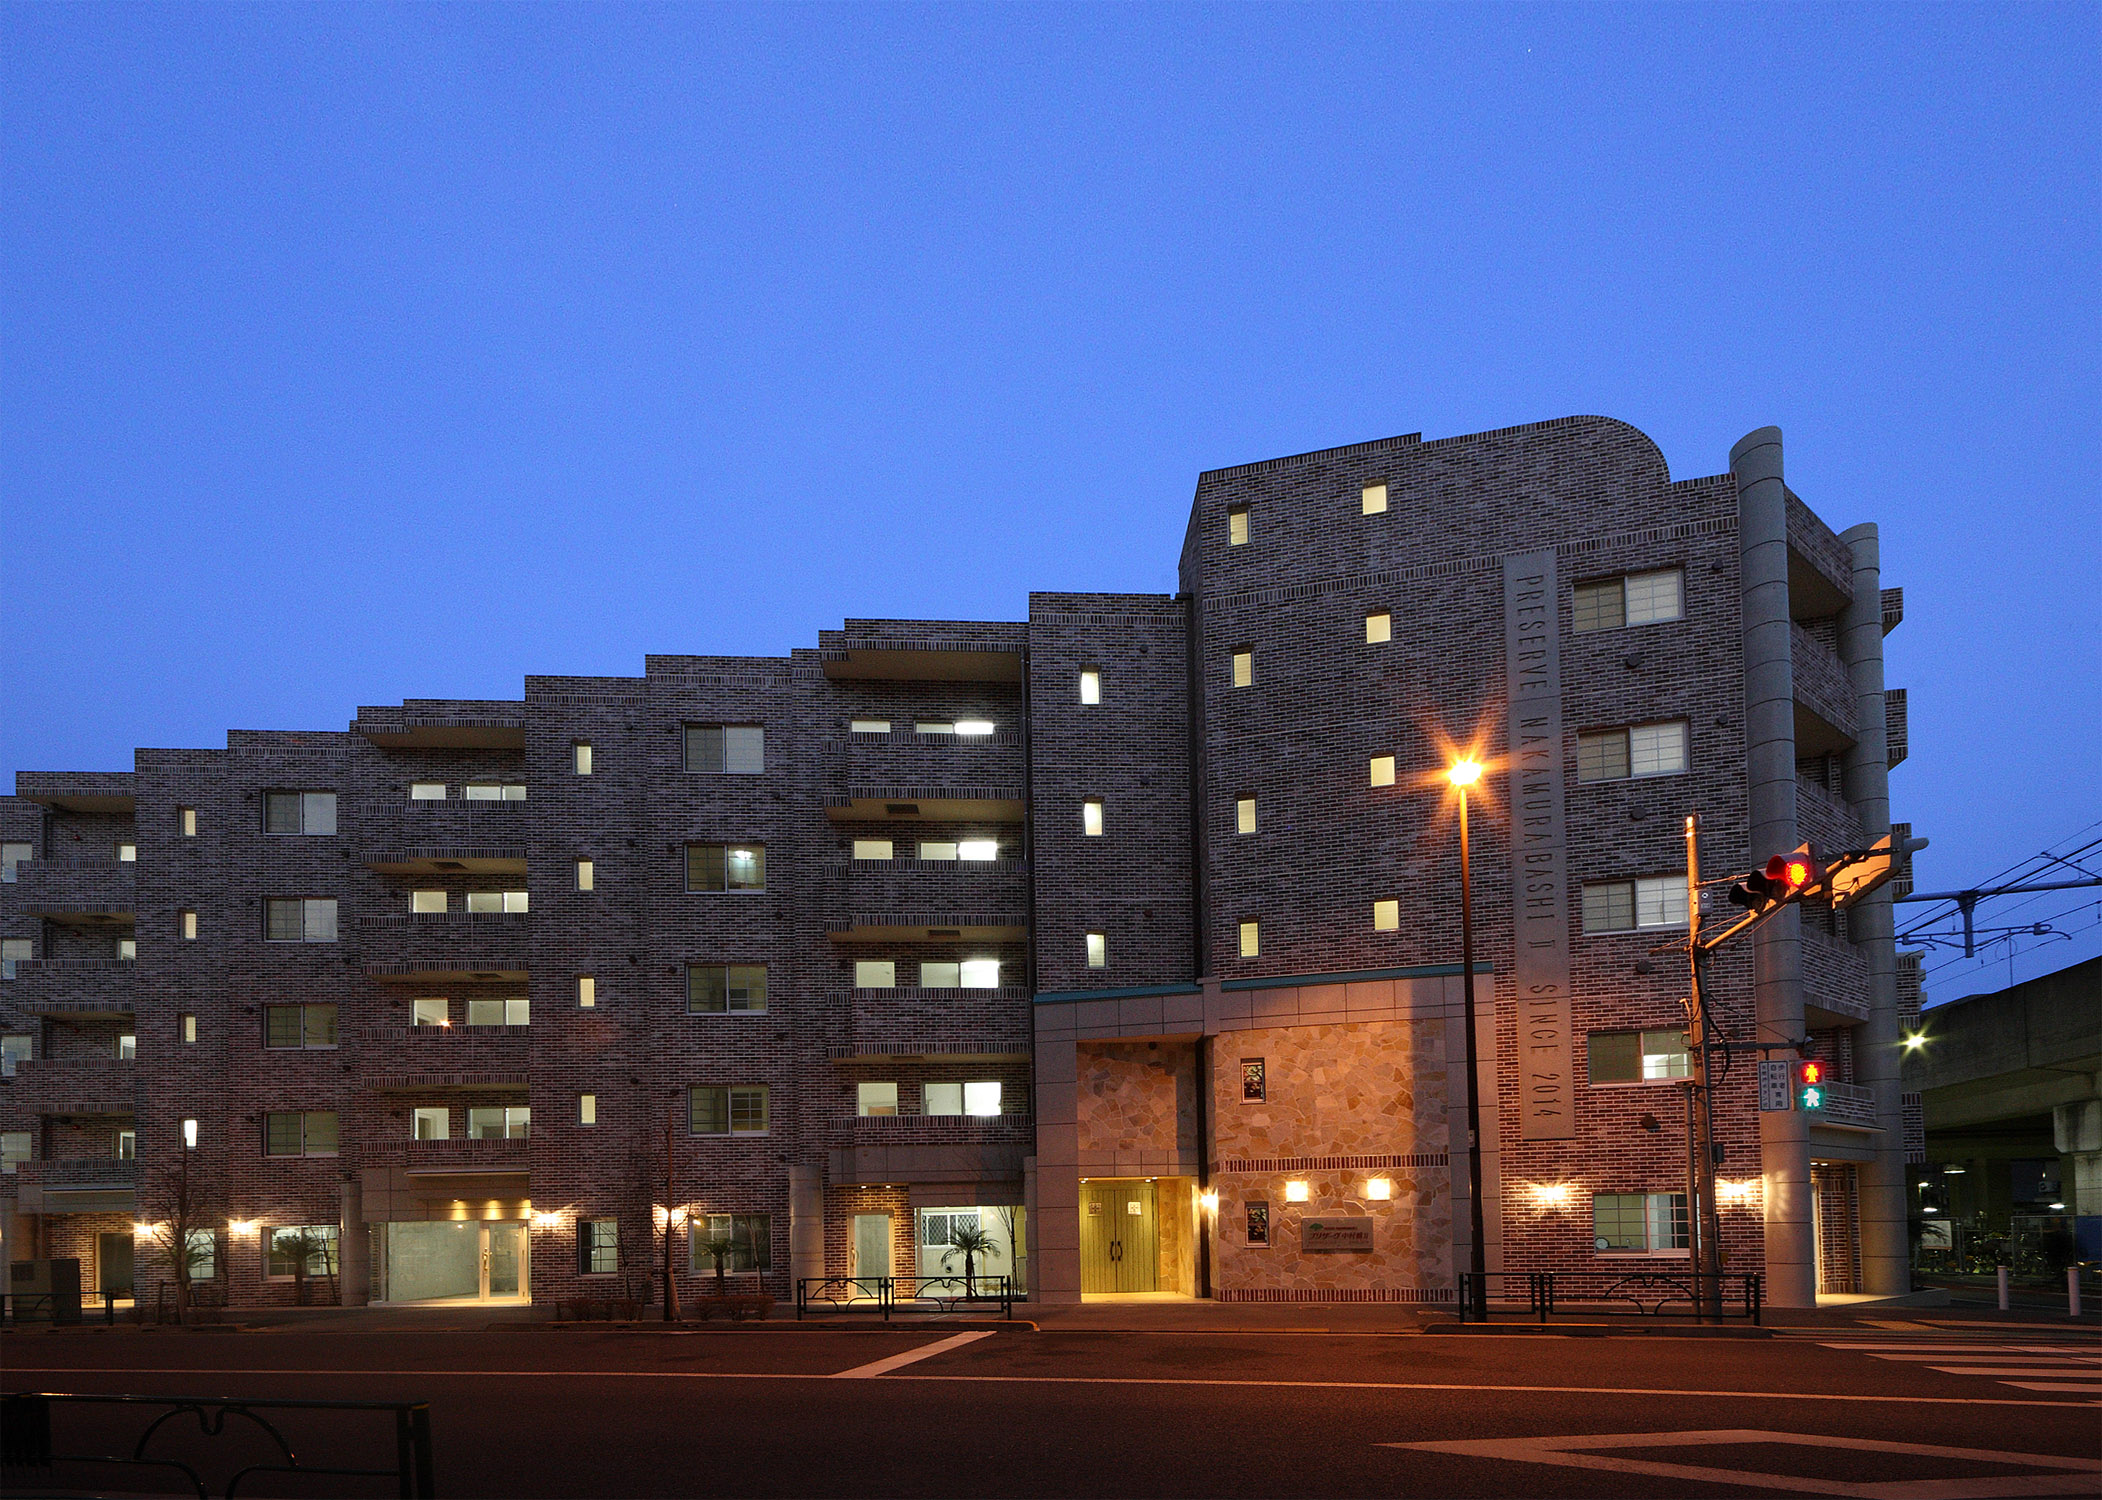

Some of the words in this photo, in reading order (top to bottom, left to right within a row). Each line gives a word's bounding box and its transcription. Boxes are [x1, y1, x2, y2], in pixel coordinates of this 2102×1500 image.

[1516, 575, 1548, 691] PRESERVE
[1520, 716, 1555, 920] NAKAMURABASHI
[1529, 984, 1559, 1053] SINCE
[1532, 1073, 1562, 1117] 2014
